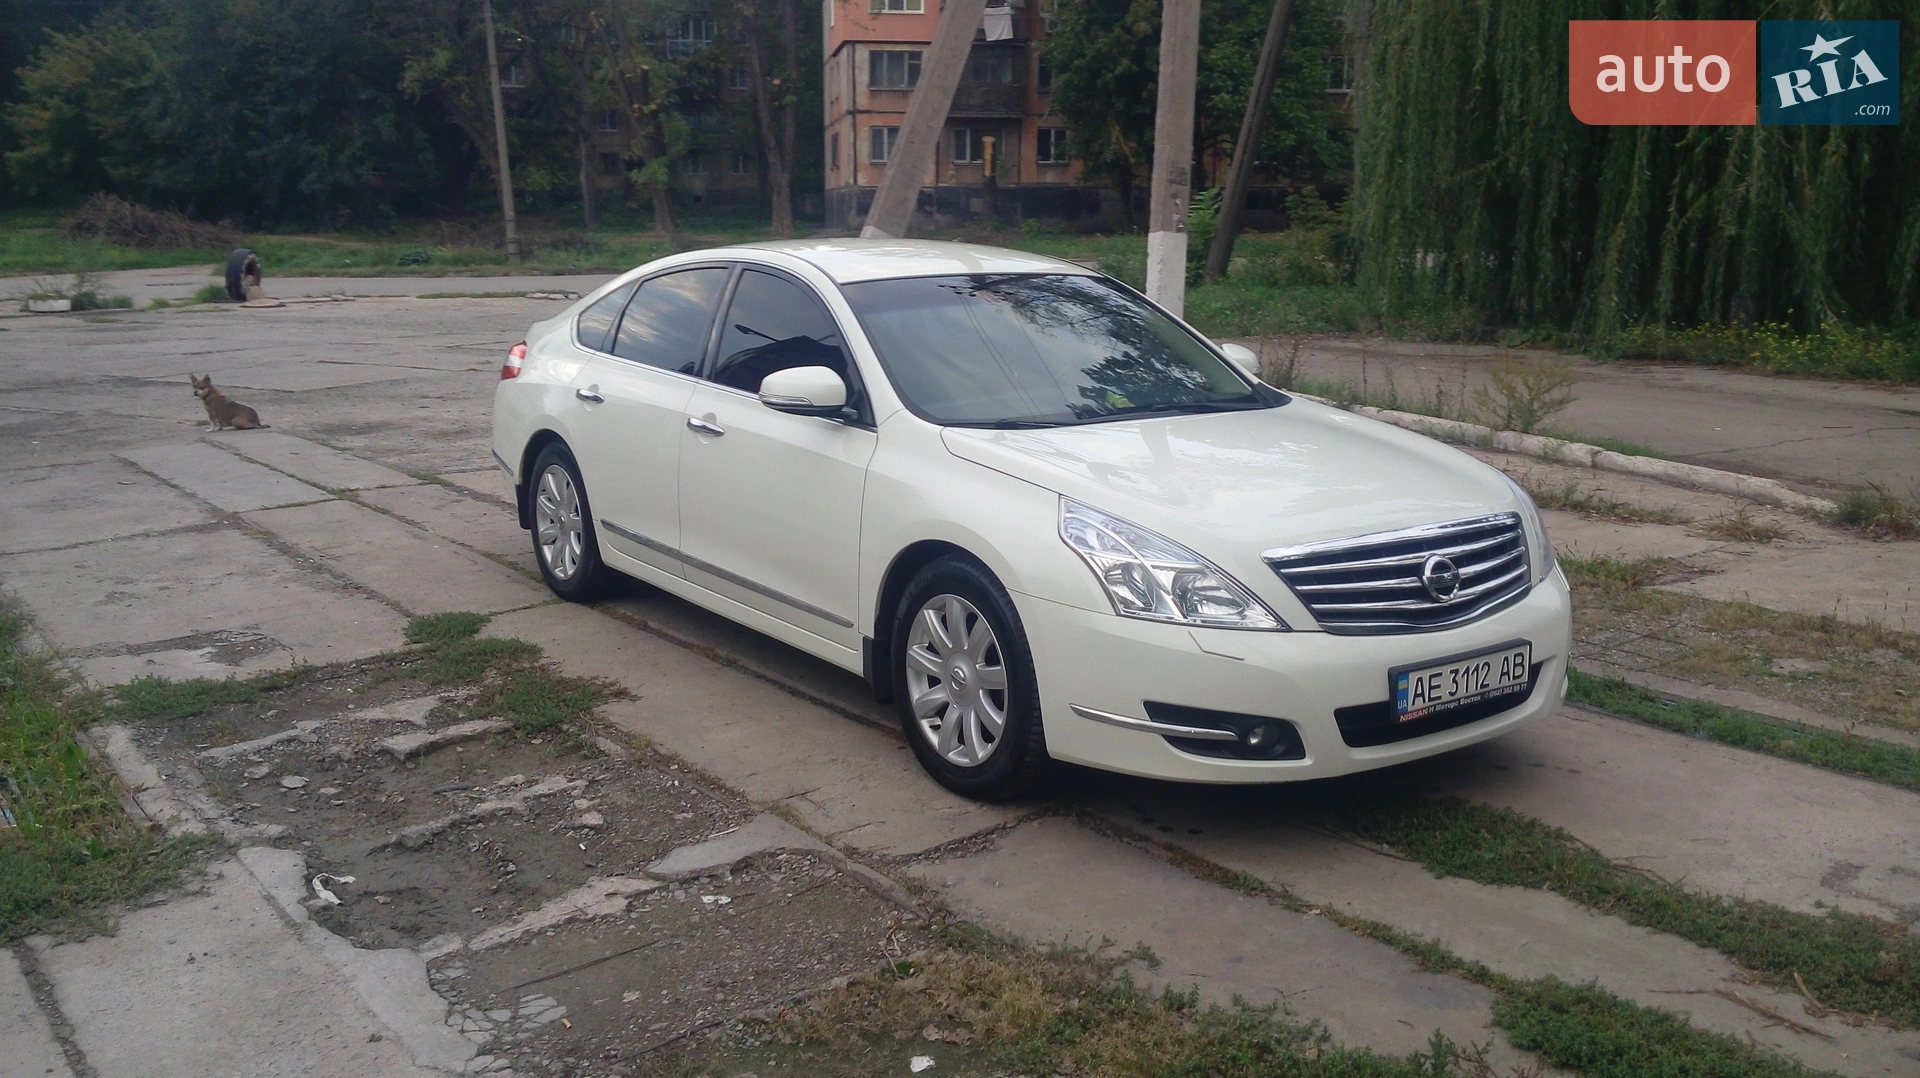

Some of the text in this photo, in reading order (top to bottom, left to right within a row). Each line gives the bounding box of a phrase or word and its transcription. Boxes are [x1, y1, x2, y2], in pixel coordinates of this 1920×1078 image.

[1411, 652, 1525, 706] AE 3112 AB
[1397, 699, 1408, 710] UA
[1400, 708, 1429, 722] NISSAN
